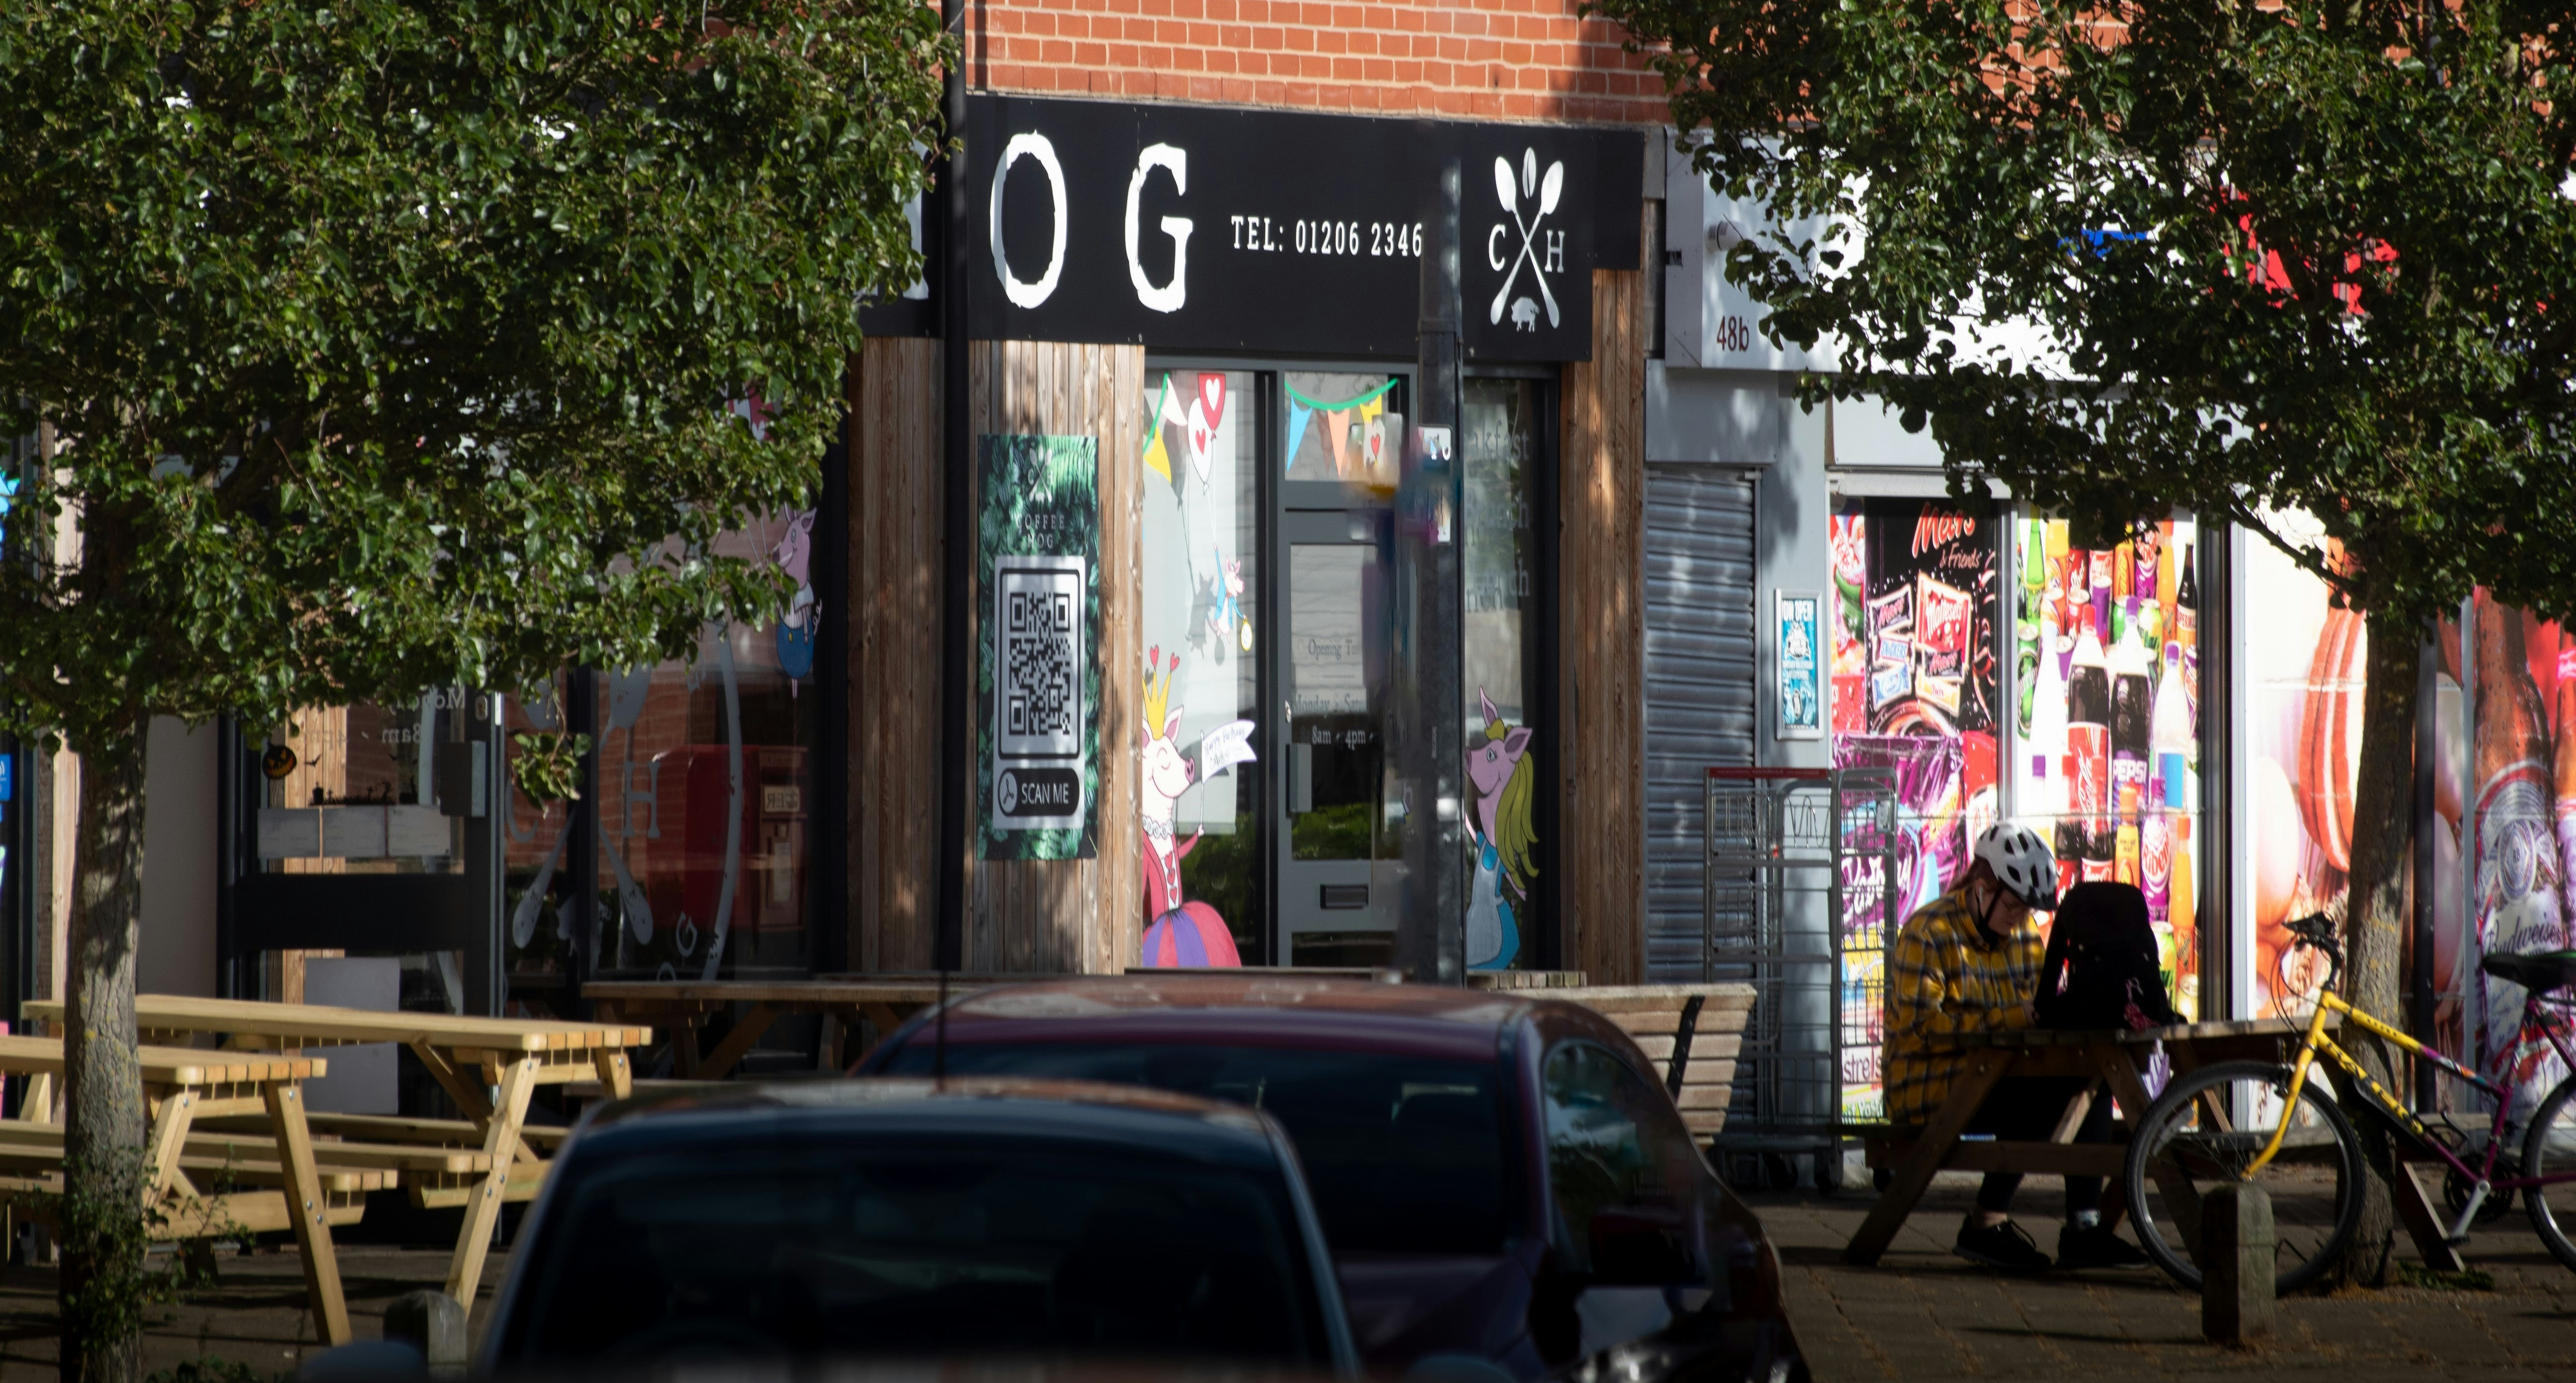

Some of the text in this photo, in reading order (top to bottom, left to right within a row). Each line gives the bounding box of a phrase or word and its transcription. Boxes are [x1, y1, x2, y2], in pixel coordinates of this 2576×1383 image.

[1231, 215, 1423, 258] TEL: 01206 2346
[1488, 224, 1565, 274] C H
[1716, 314, 1749, 352] 48b
[1016, 514, 1065, 531] COFFEE
[1027, 533, 1053, 549] HOG
[1948, 542, 1980, 569] Friends
[1926, 599, 1963, 642] Maltesers
[1308, 638, 1342, 661] Opening
[1312, 724, 1331, 745] 8am
[1345, 728, 1366, 751] 4pm
[2112, 759, 2147, 783] PEPSI
[1021, 782, 1069, 805] SCAN ME
[2143, 832, 2171, 876] Riben
[1843, 1047, 1882, 1084] strels
